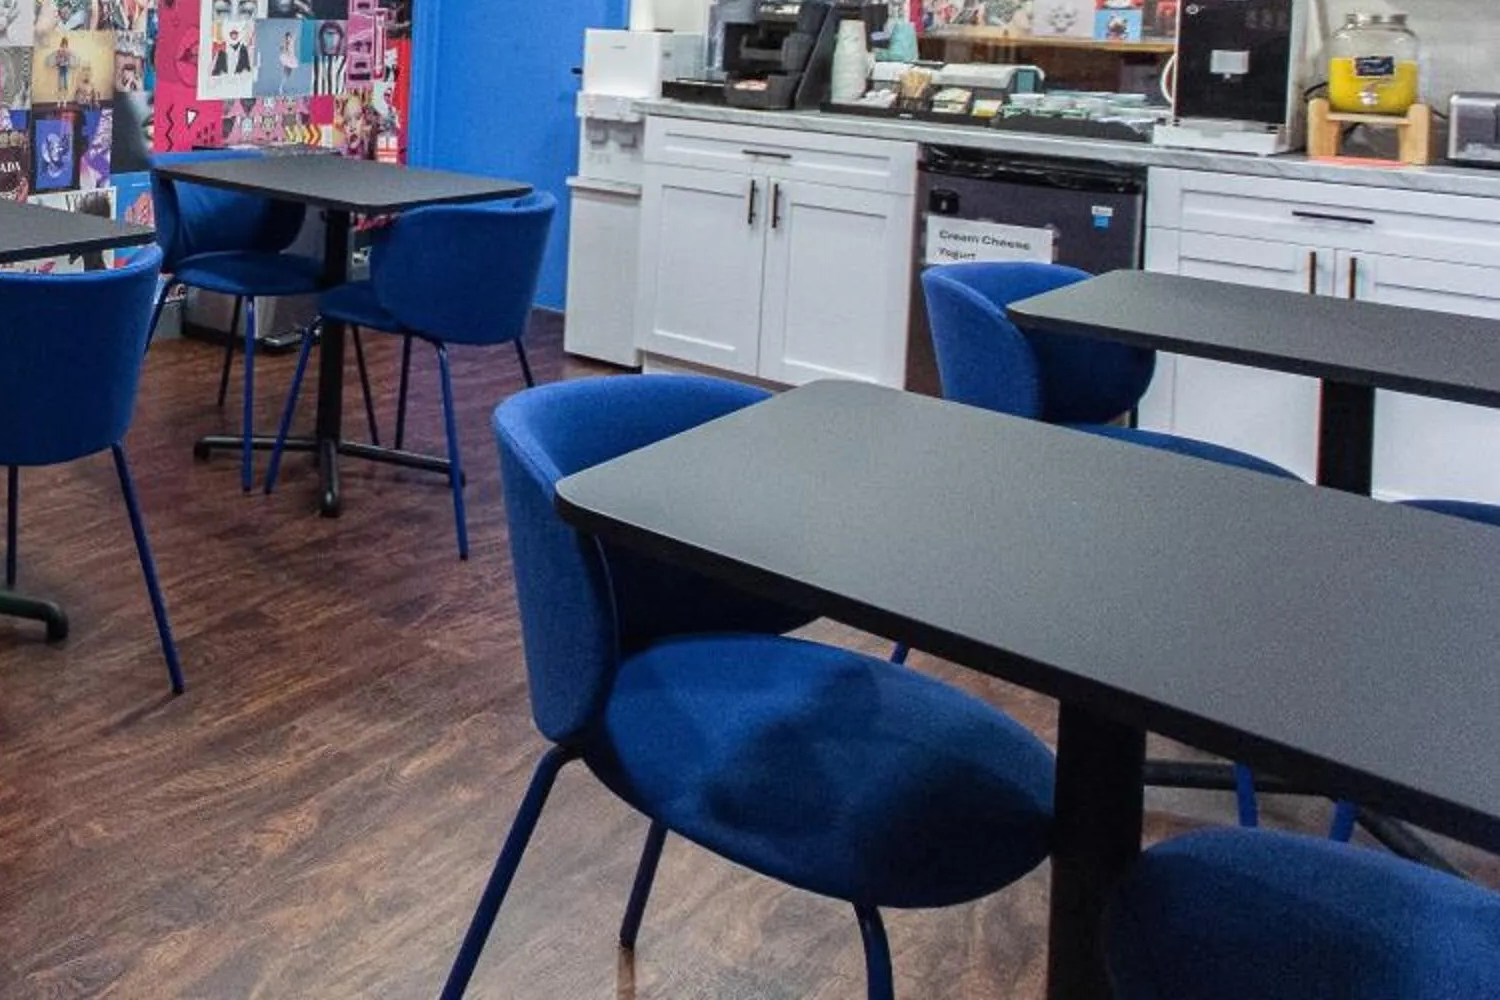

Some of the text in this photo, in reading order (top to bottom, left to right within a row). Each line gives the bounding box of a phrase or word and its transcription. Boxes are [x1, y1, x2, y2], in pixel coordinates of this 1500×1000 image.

[939, 230, 1032, 251] Cream Cheese
[938, 247, 977, 261] Yogurt
